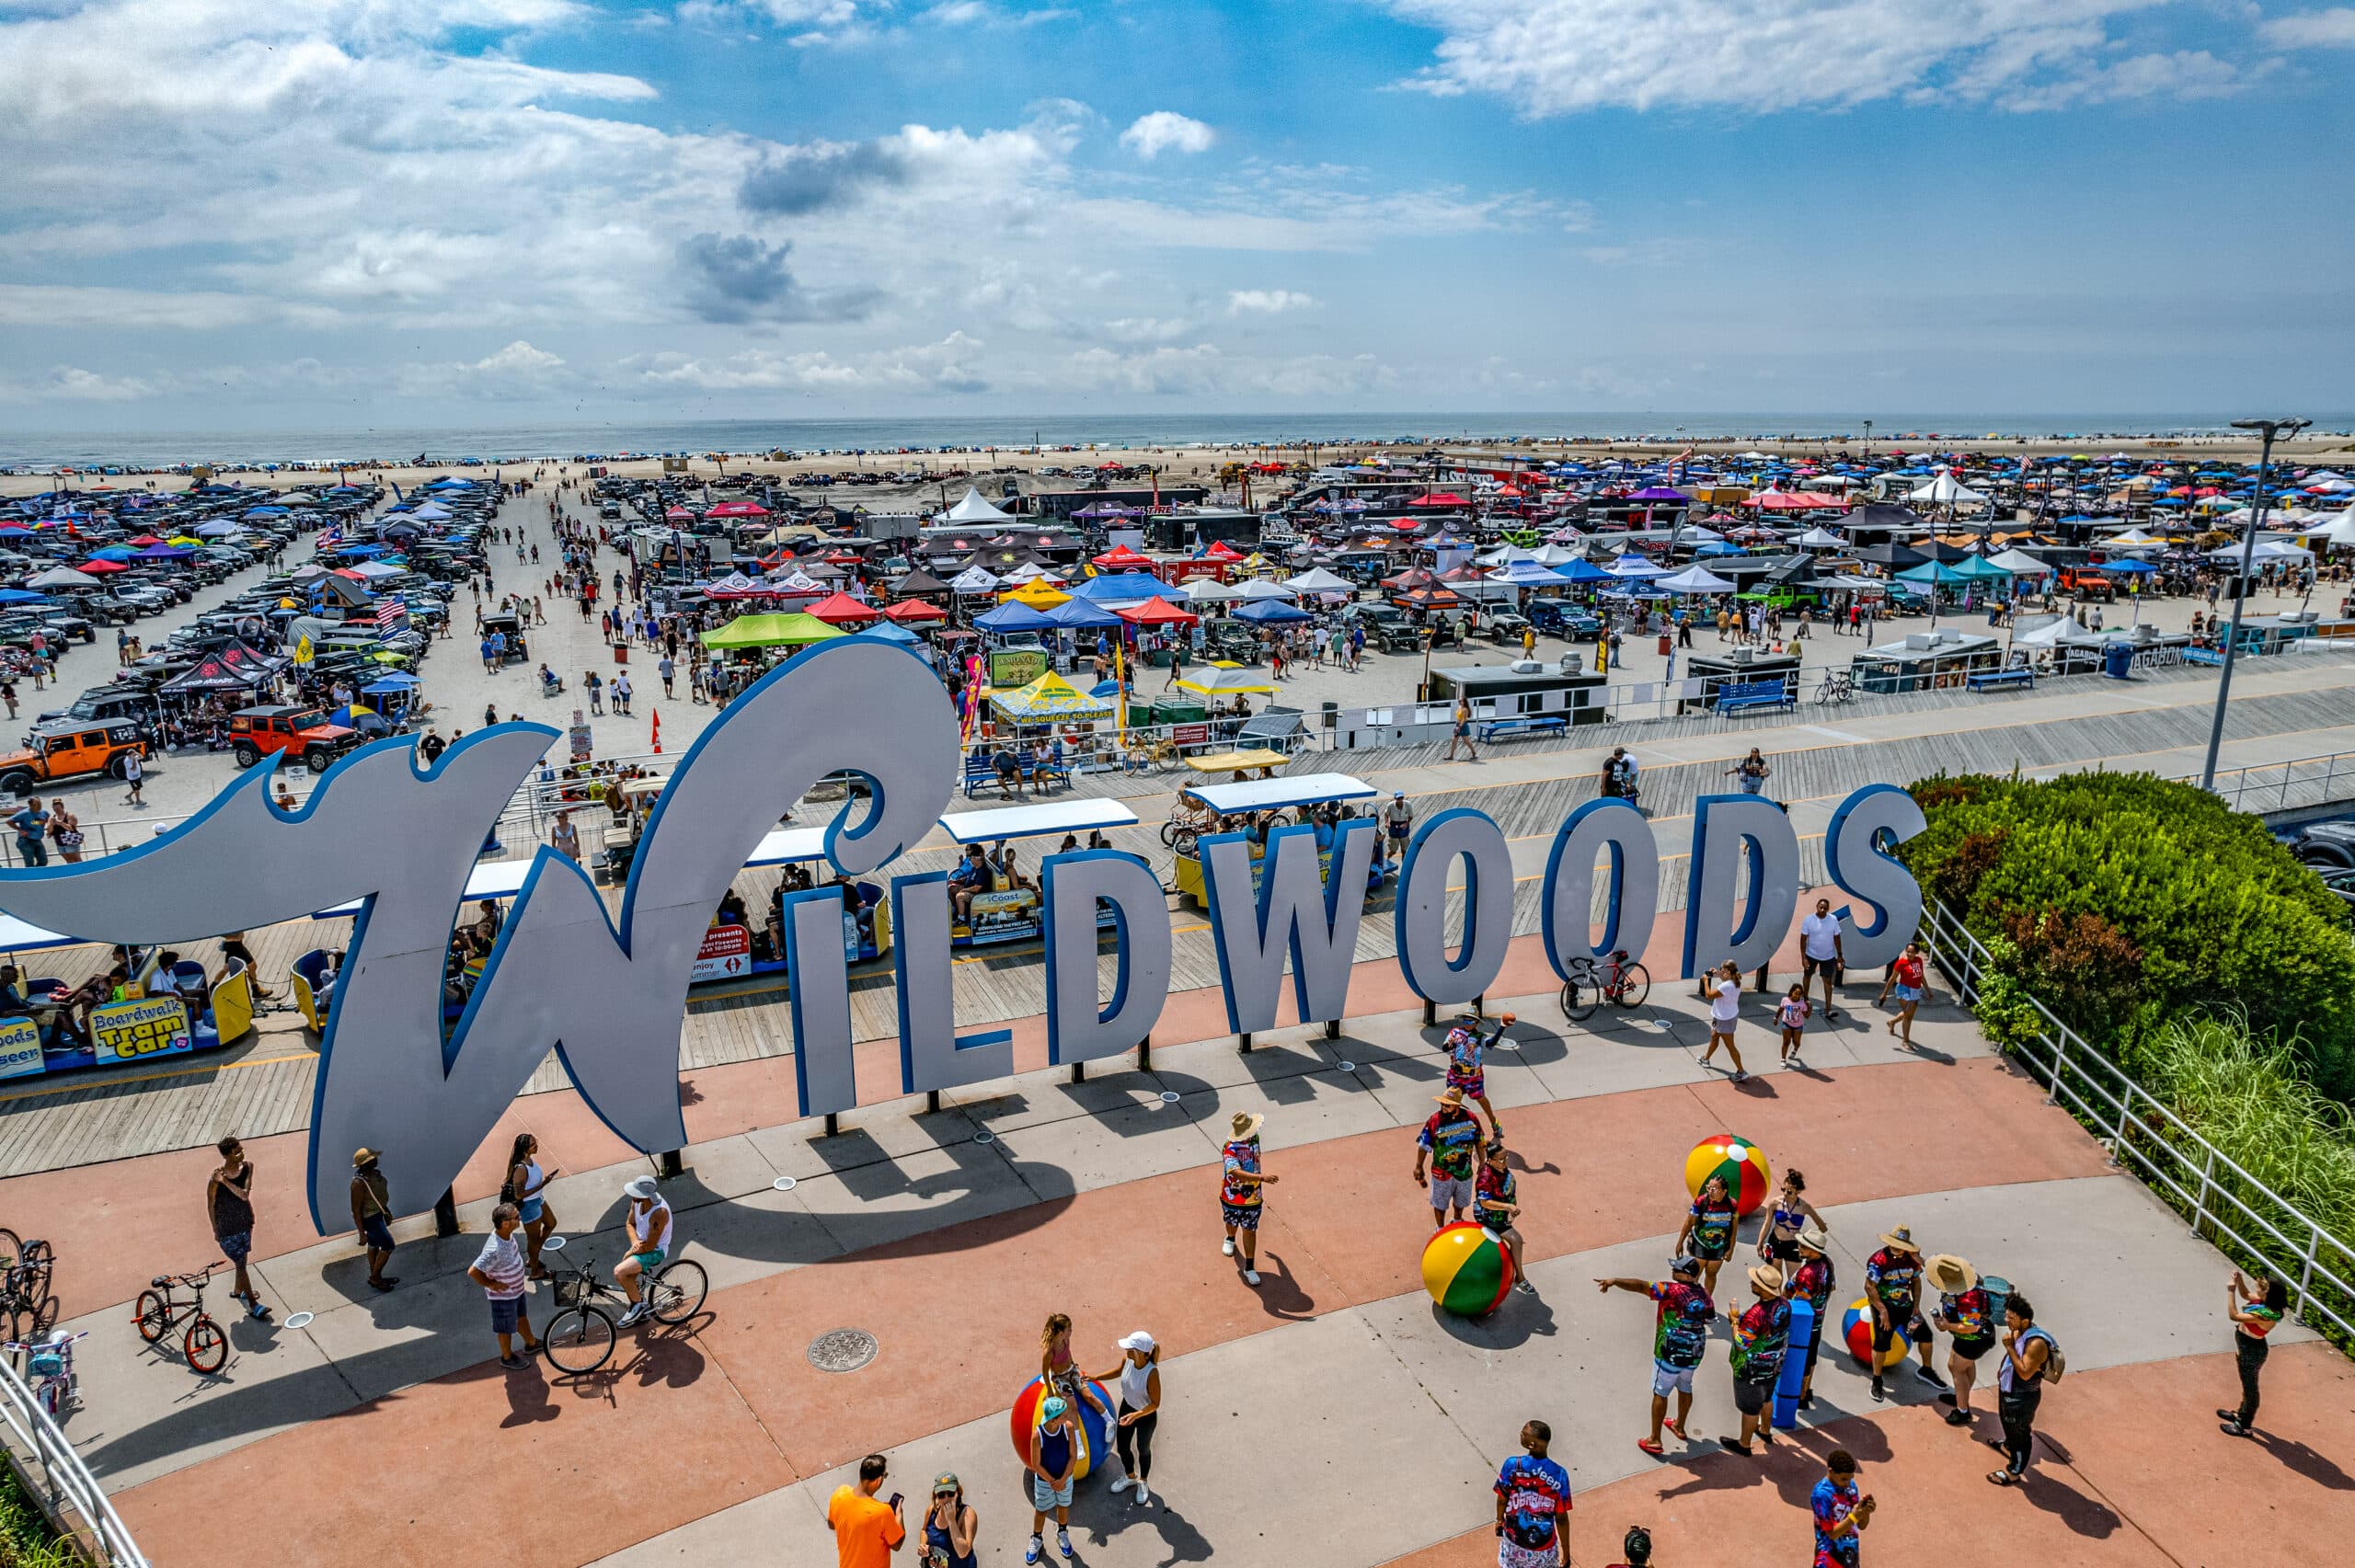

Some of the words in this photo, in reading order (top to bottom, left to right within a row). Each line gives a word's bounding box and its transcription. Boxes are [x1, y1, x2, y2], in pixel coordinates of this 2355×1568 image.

[1036, 715, 1070, 723] SQUEEZE
[1085, 711, 1112, 719] PLEASE
[988, 893, 1020, 903] iCoast
[0, 635, 1928, 1236] WILDWOODS
[708, 930, 742, 940] presents
[692, 970, 721, 979] ummer
[93, 999, 182, 1029] Boardwalk
[98, 1015, 185, 1047] Tram
[1532, 1466, 1562, 1491] Jeep
